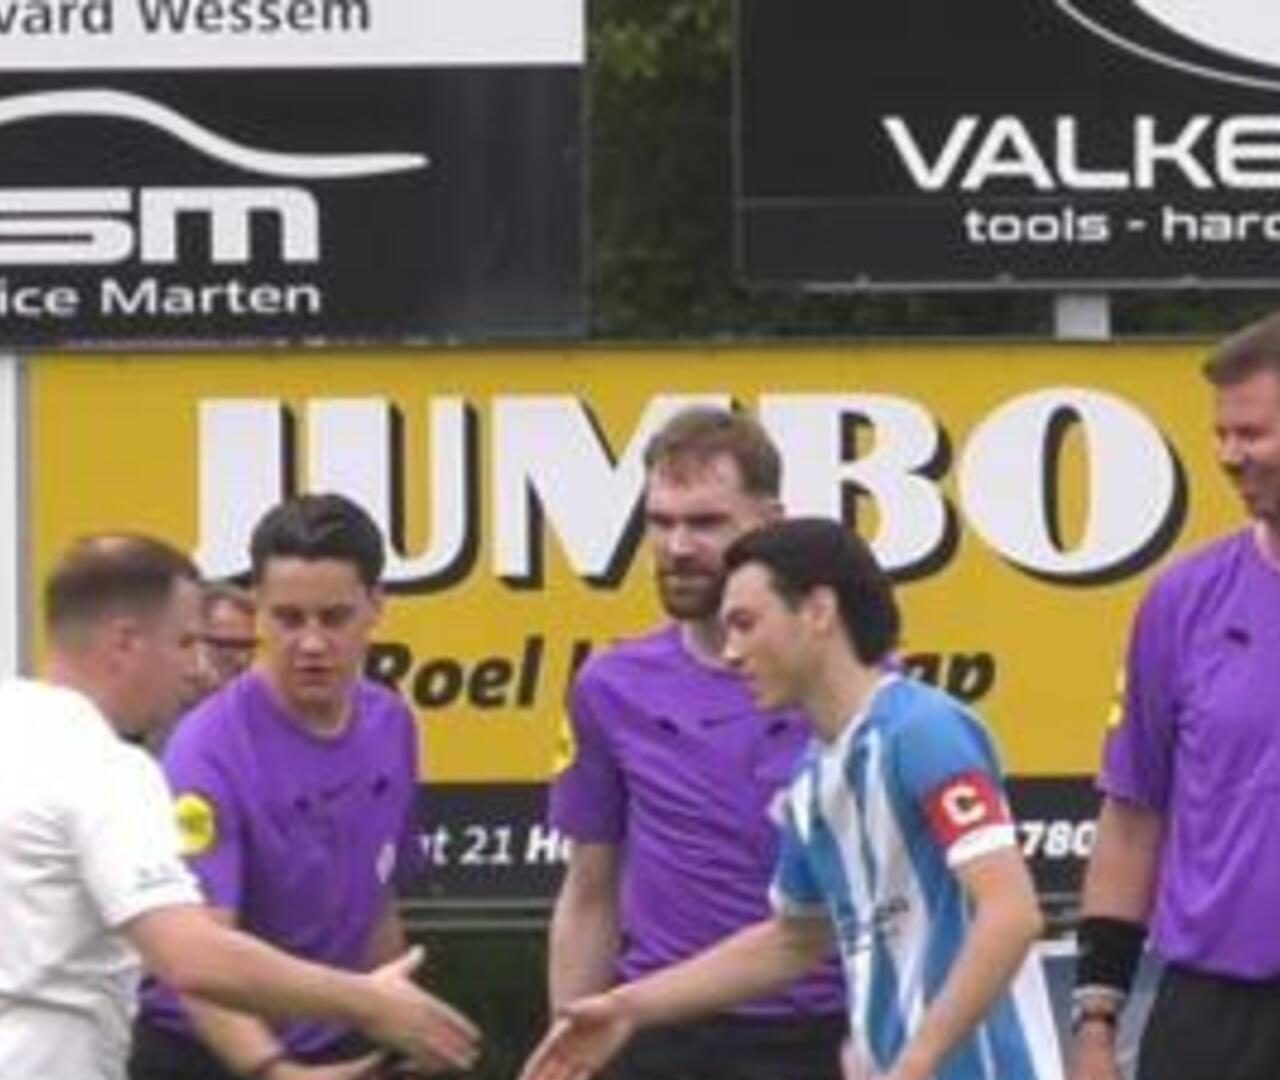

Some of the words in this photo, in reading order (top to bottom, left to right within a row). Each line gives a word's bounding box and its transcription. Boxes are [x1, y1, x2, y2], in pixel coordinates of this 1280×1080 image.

[137, 0, 371, 34] Wessem
[964, 206, 1111, 243] tools
[100, 277, 321, 315] Marten
[941, 784, 986, 826] C
